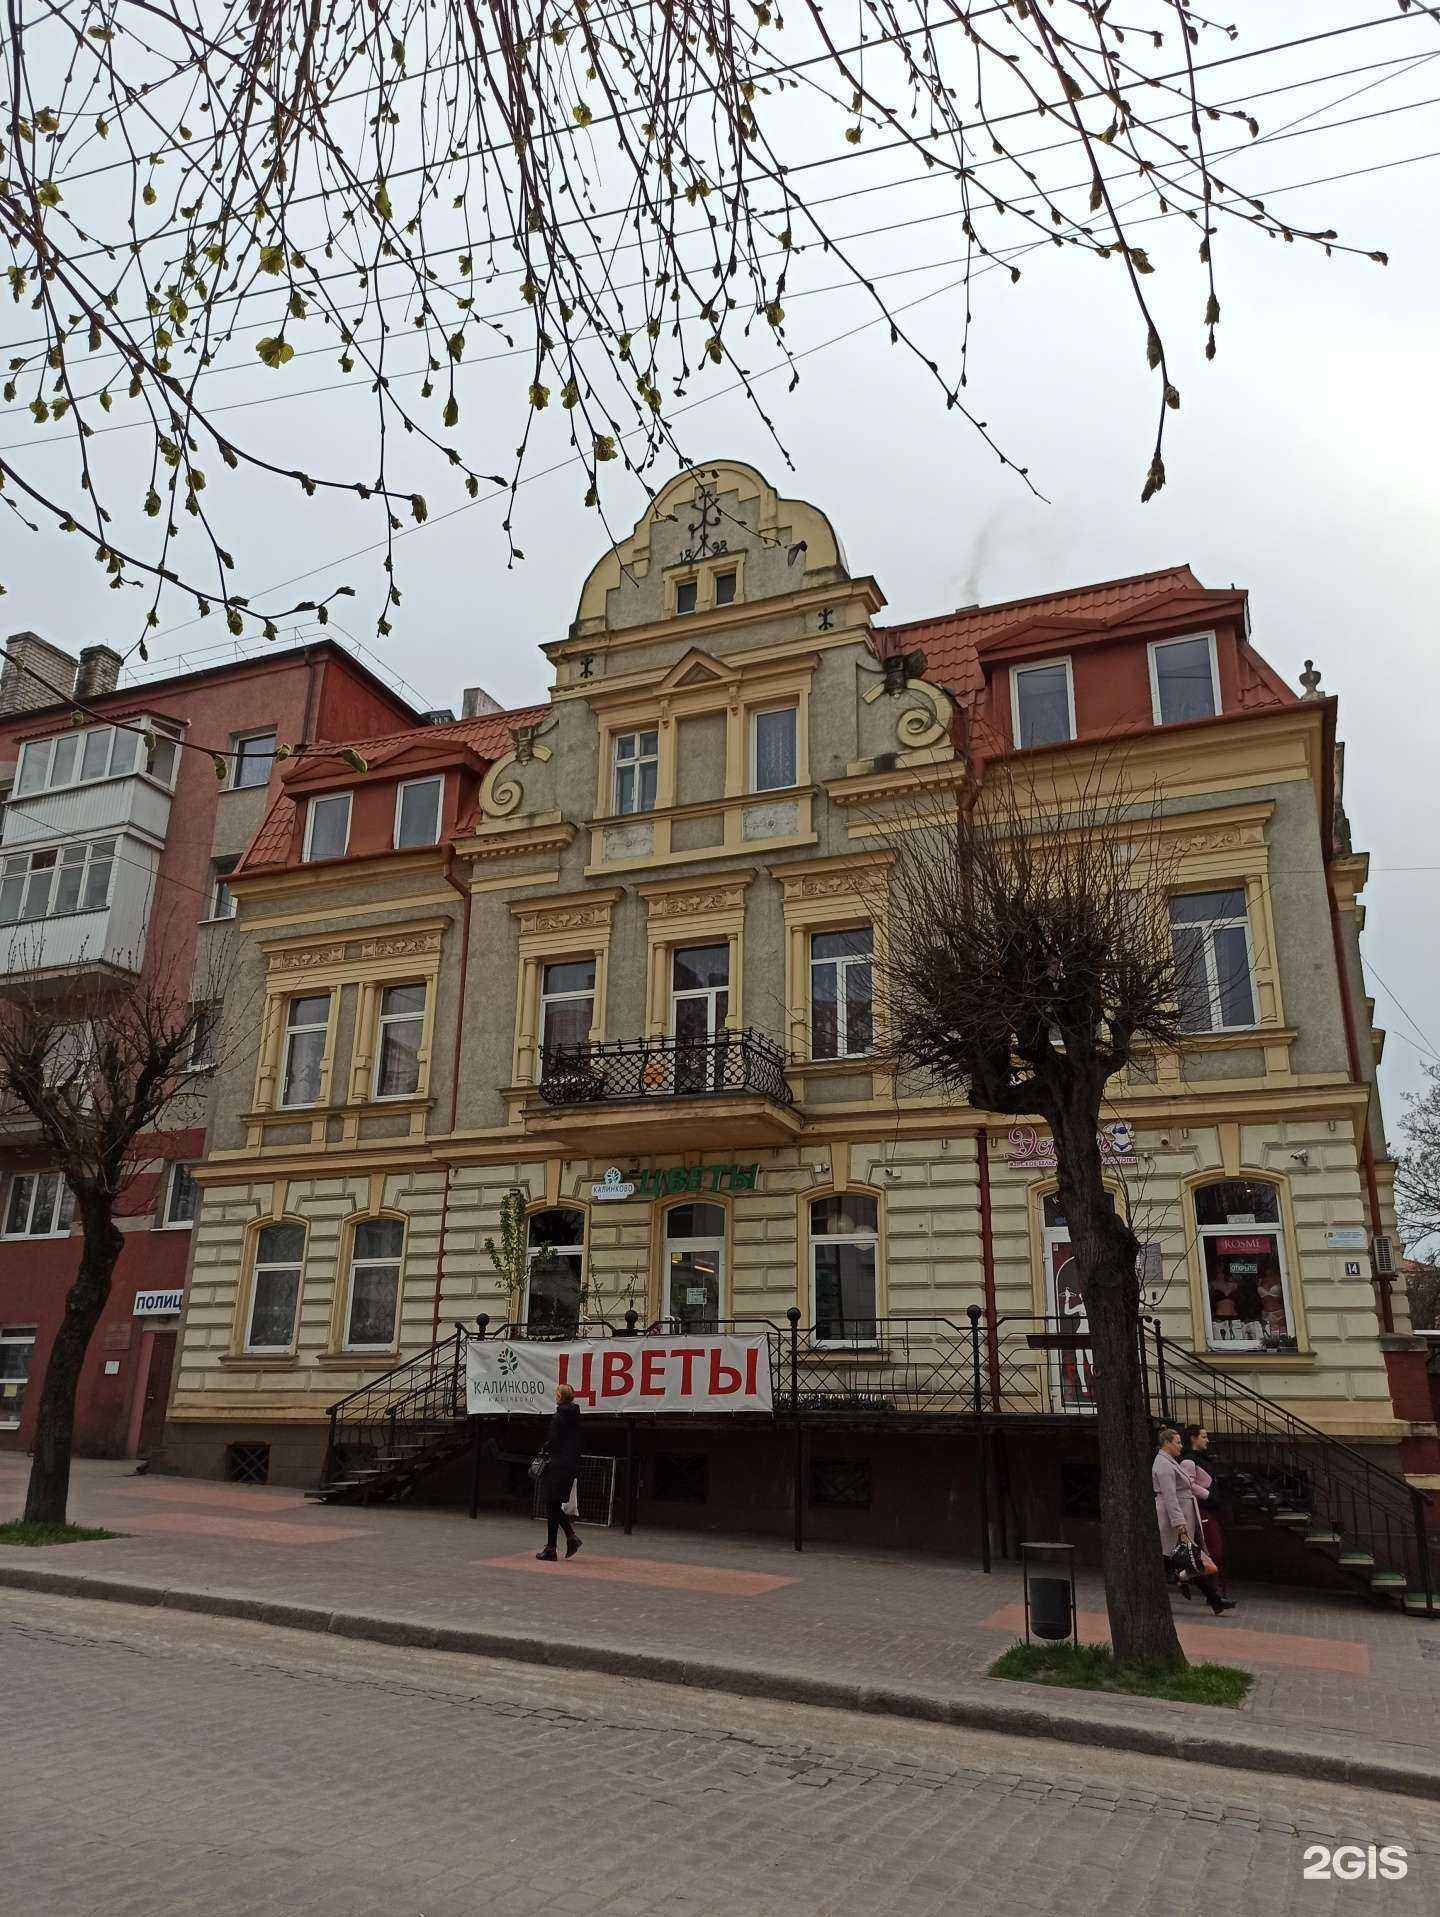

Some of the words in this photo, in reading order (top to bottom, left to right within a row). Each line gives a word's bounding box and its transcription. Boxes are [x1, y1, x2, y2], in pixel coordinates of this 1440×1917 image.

[640, 1163, 760, 1198] ЦВЕТЫ
[592, 1184, 633, 1194] КАЛИНКОВО
[1347, 1263, 1358, 1274] 14
[558, 1348, 759, 1406] ЦВЕТЫ
[473, 1380, 545, 1395] КАЛИНКОВО
